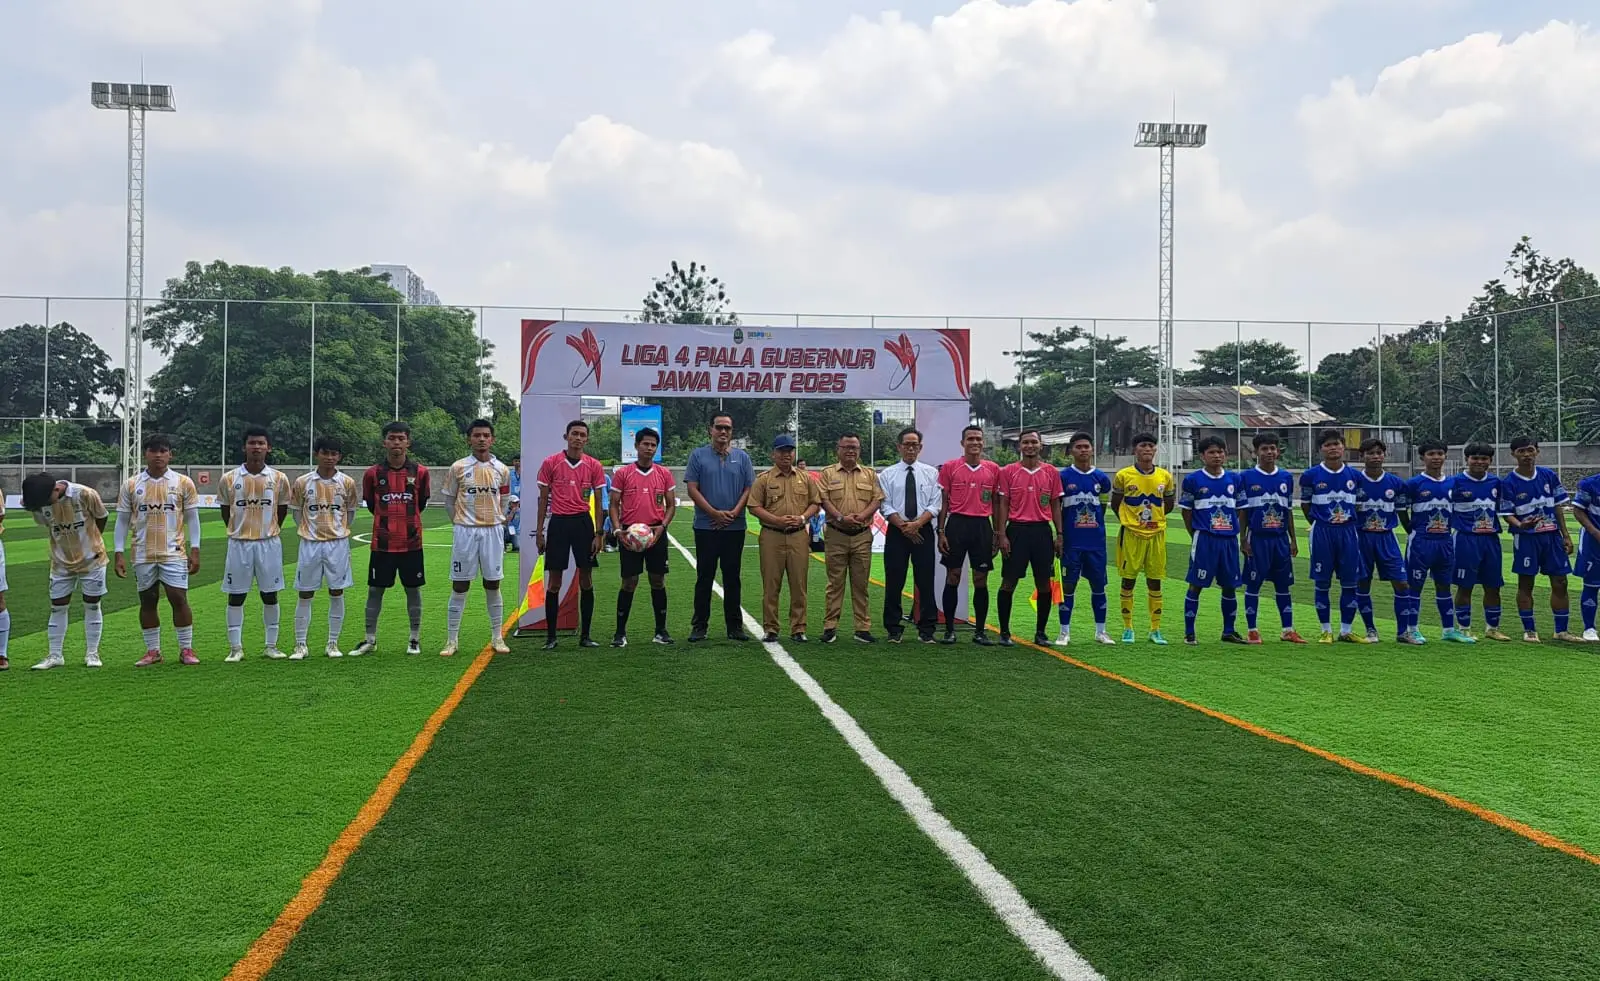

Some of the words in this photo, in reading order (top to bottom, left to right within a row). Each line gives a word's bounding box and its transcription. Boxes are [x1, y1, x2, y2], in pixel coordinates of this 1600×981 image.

[621, 344, 669, 366] LIGA
[675, 346, 690, 366] 4
[695, 346, 754, 368] PIALA
[760, 347, 876, 369] GUBERNUR
[651, 370, 711, 392] JAWA
[717, 371, 786, 393] BARAT
[789, 373, 848, 393] 2025
[200, 475, 208, 484] C
[382, 492, 413, 502] GWR
[139, 503, 176, 512] GWR
[453, 561, 461, 573] 21
[1314, 562, 1322, 573] 3
[1522, 557, 1530, 568] 6
[1587, 561, 1593, 572] 7
[227, 573, 233, 585] 5
[372, 567, 376, 580] 1
[1198, 569, 1207, 580] 19
[1413, 569, 1422, 580] 15
[1458, 568, 1466, 579] 11
